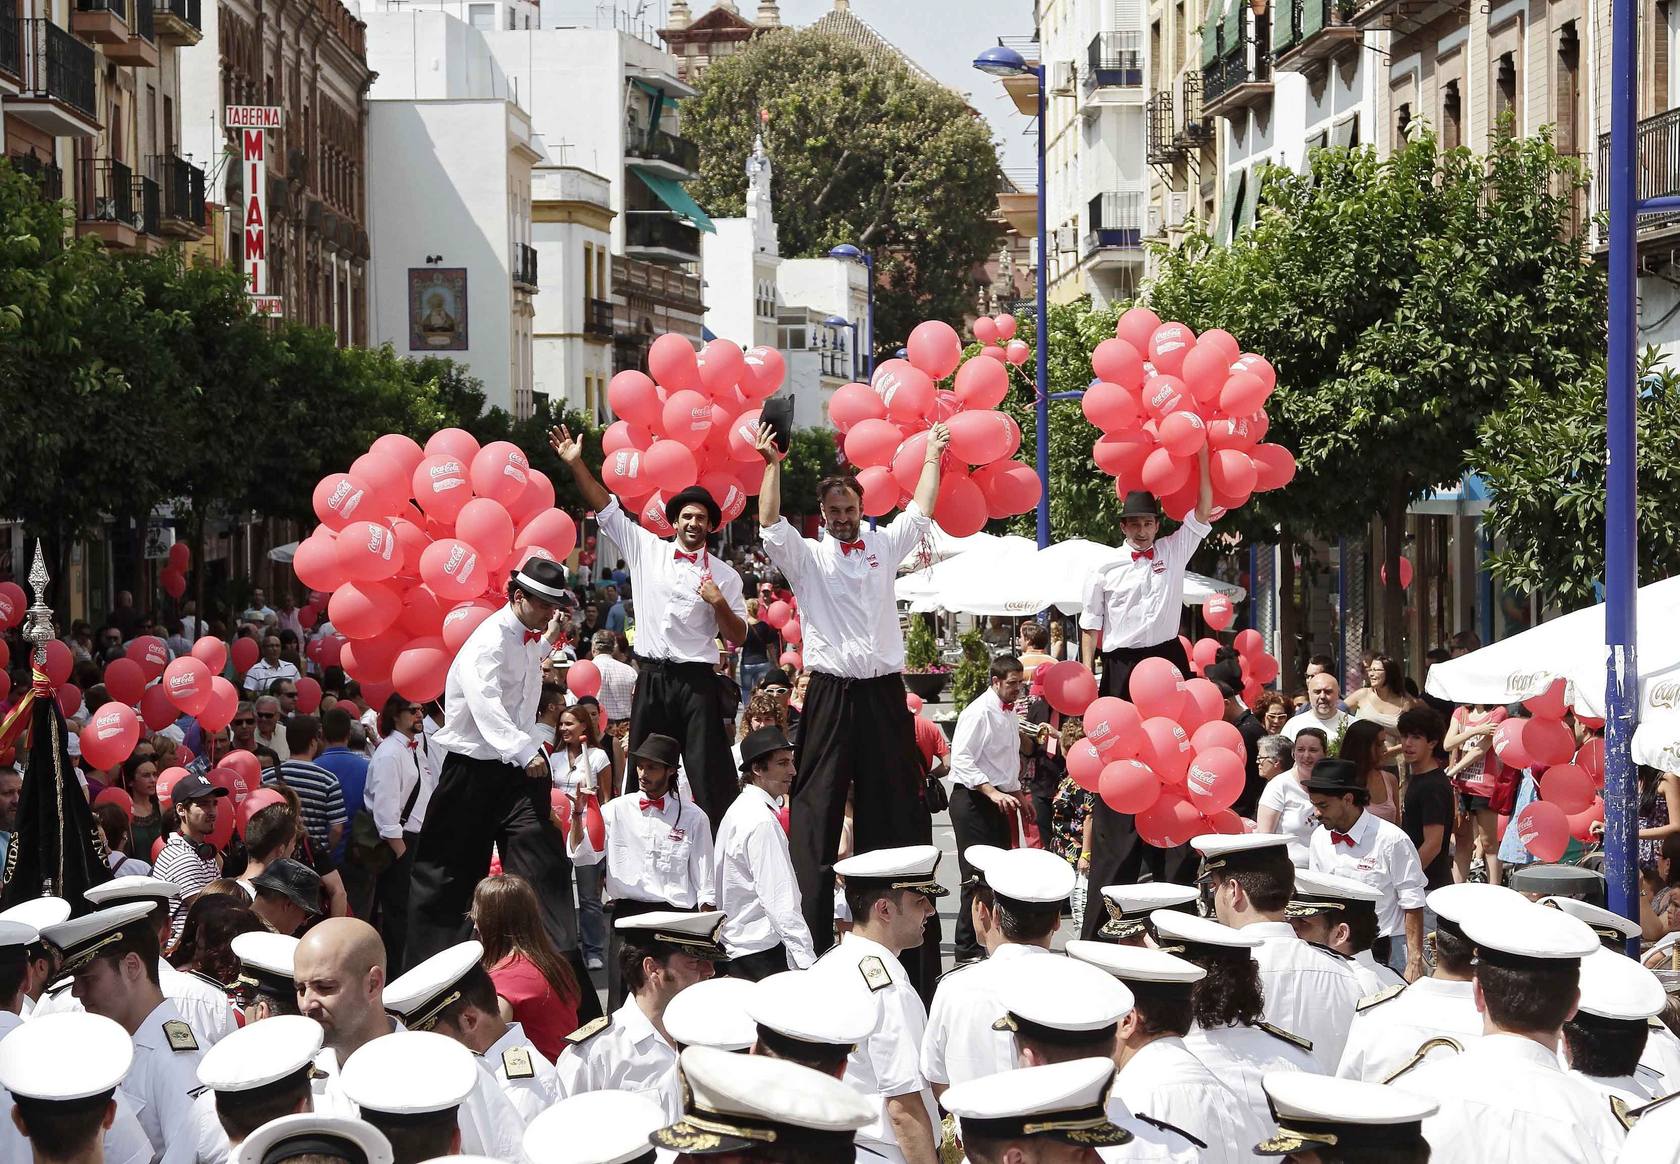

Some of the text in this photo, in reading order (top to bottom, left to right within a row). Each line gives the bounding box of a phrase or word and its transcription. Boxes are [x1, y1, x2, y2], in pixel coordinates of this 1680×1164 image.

[227, 106, 281, 126] TABERNA
[244, 130, 264, 293] MIAMI
[1152, 384, 1174, 408] Coca-Cola
[430, 461, 462, 478] Coca-Cola
[327, 479, 354, 510] Coca-Cola
[367, 524, 384, 554] Coca-Cola
[443, 544, 466, 576] Coca-Cola
[170, 671, 196, 689] Coca-Cola
[95, 711, 121, 729] Coca-Cola
[1190, 764, 1217, 787] Coca-Cola
[3, 831, 20, 884] CAIDAS
